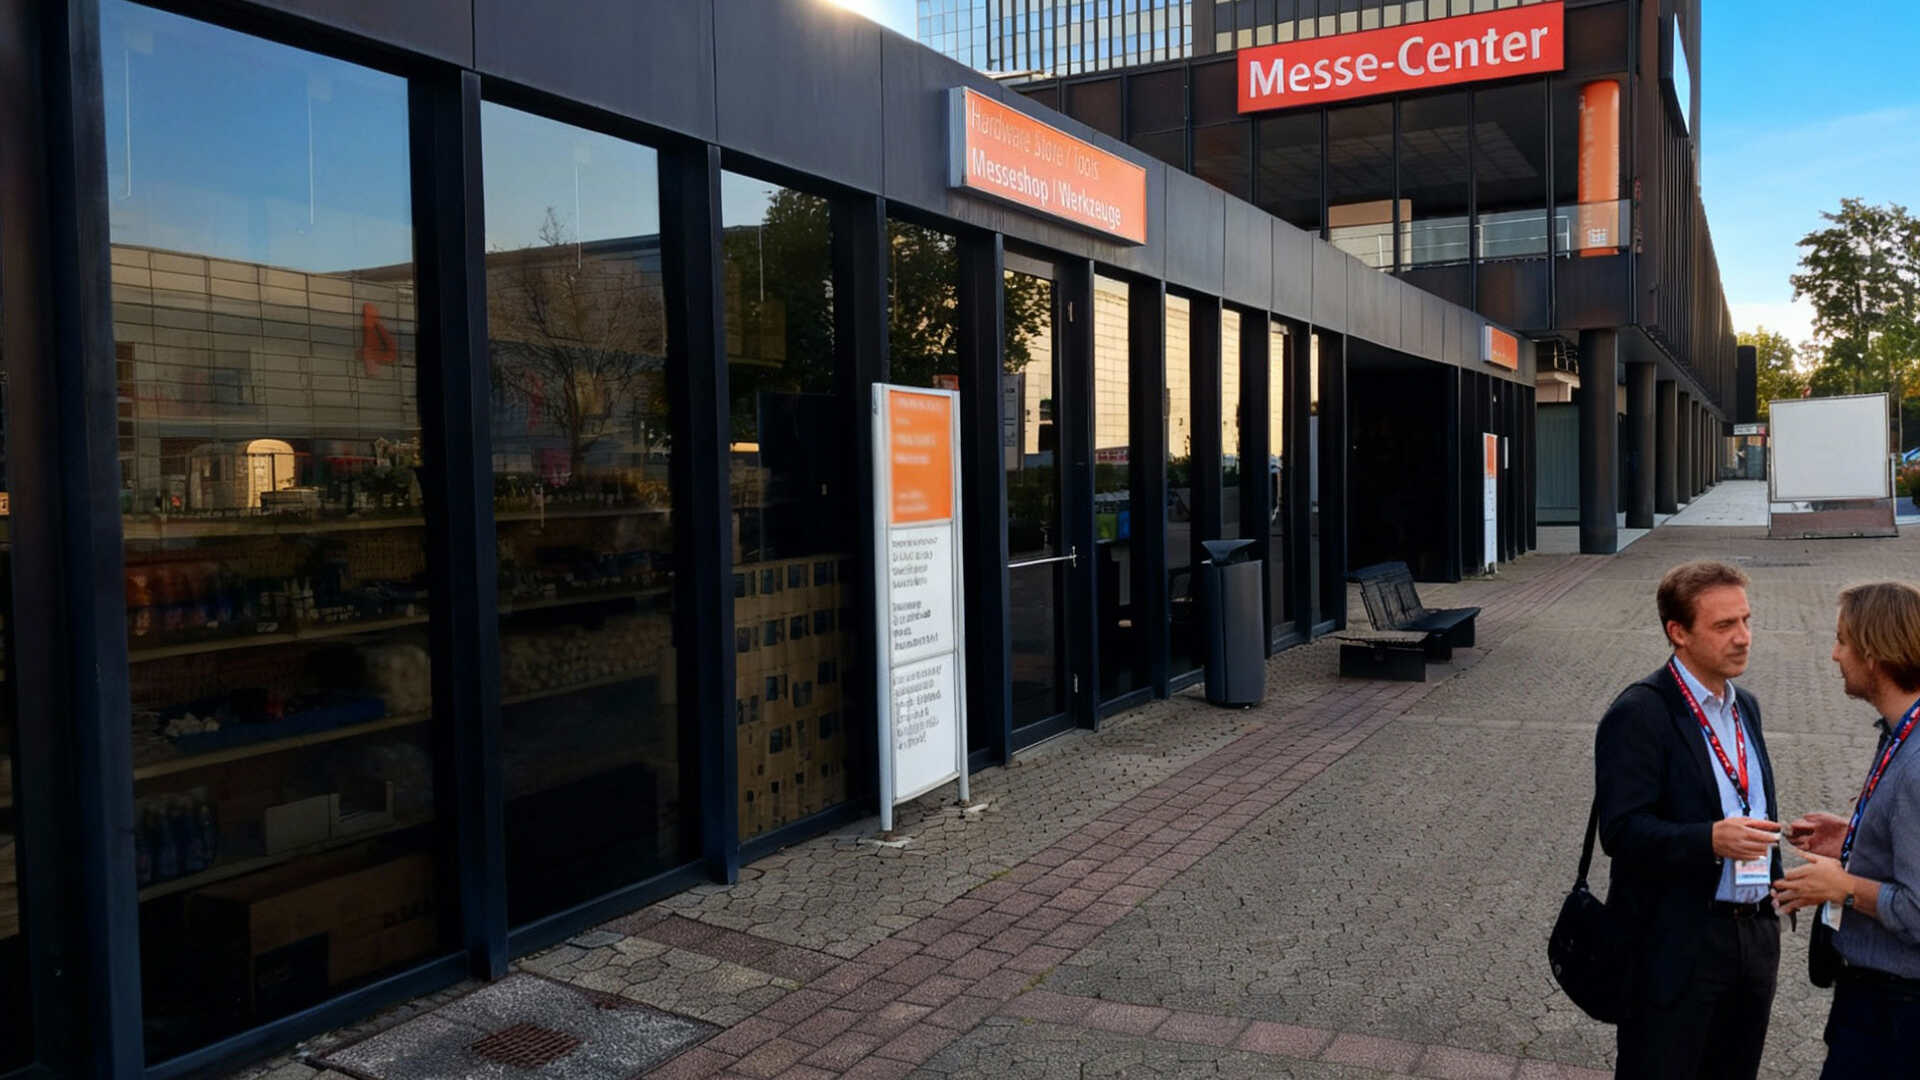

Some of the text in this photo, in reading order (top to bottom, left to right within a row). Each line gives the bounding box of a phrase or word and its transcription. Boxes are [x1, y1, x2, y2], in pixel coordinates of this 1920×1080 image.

[1249, 26, 1548, 99] Messe-Center
[971, 99, 1032, 153] Hardware
[1034, 132, 1064, 168] Store
[972, 147, 1049, 206] Messeshop
[1059, 180, 1121, 230] Werkzeuge
